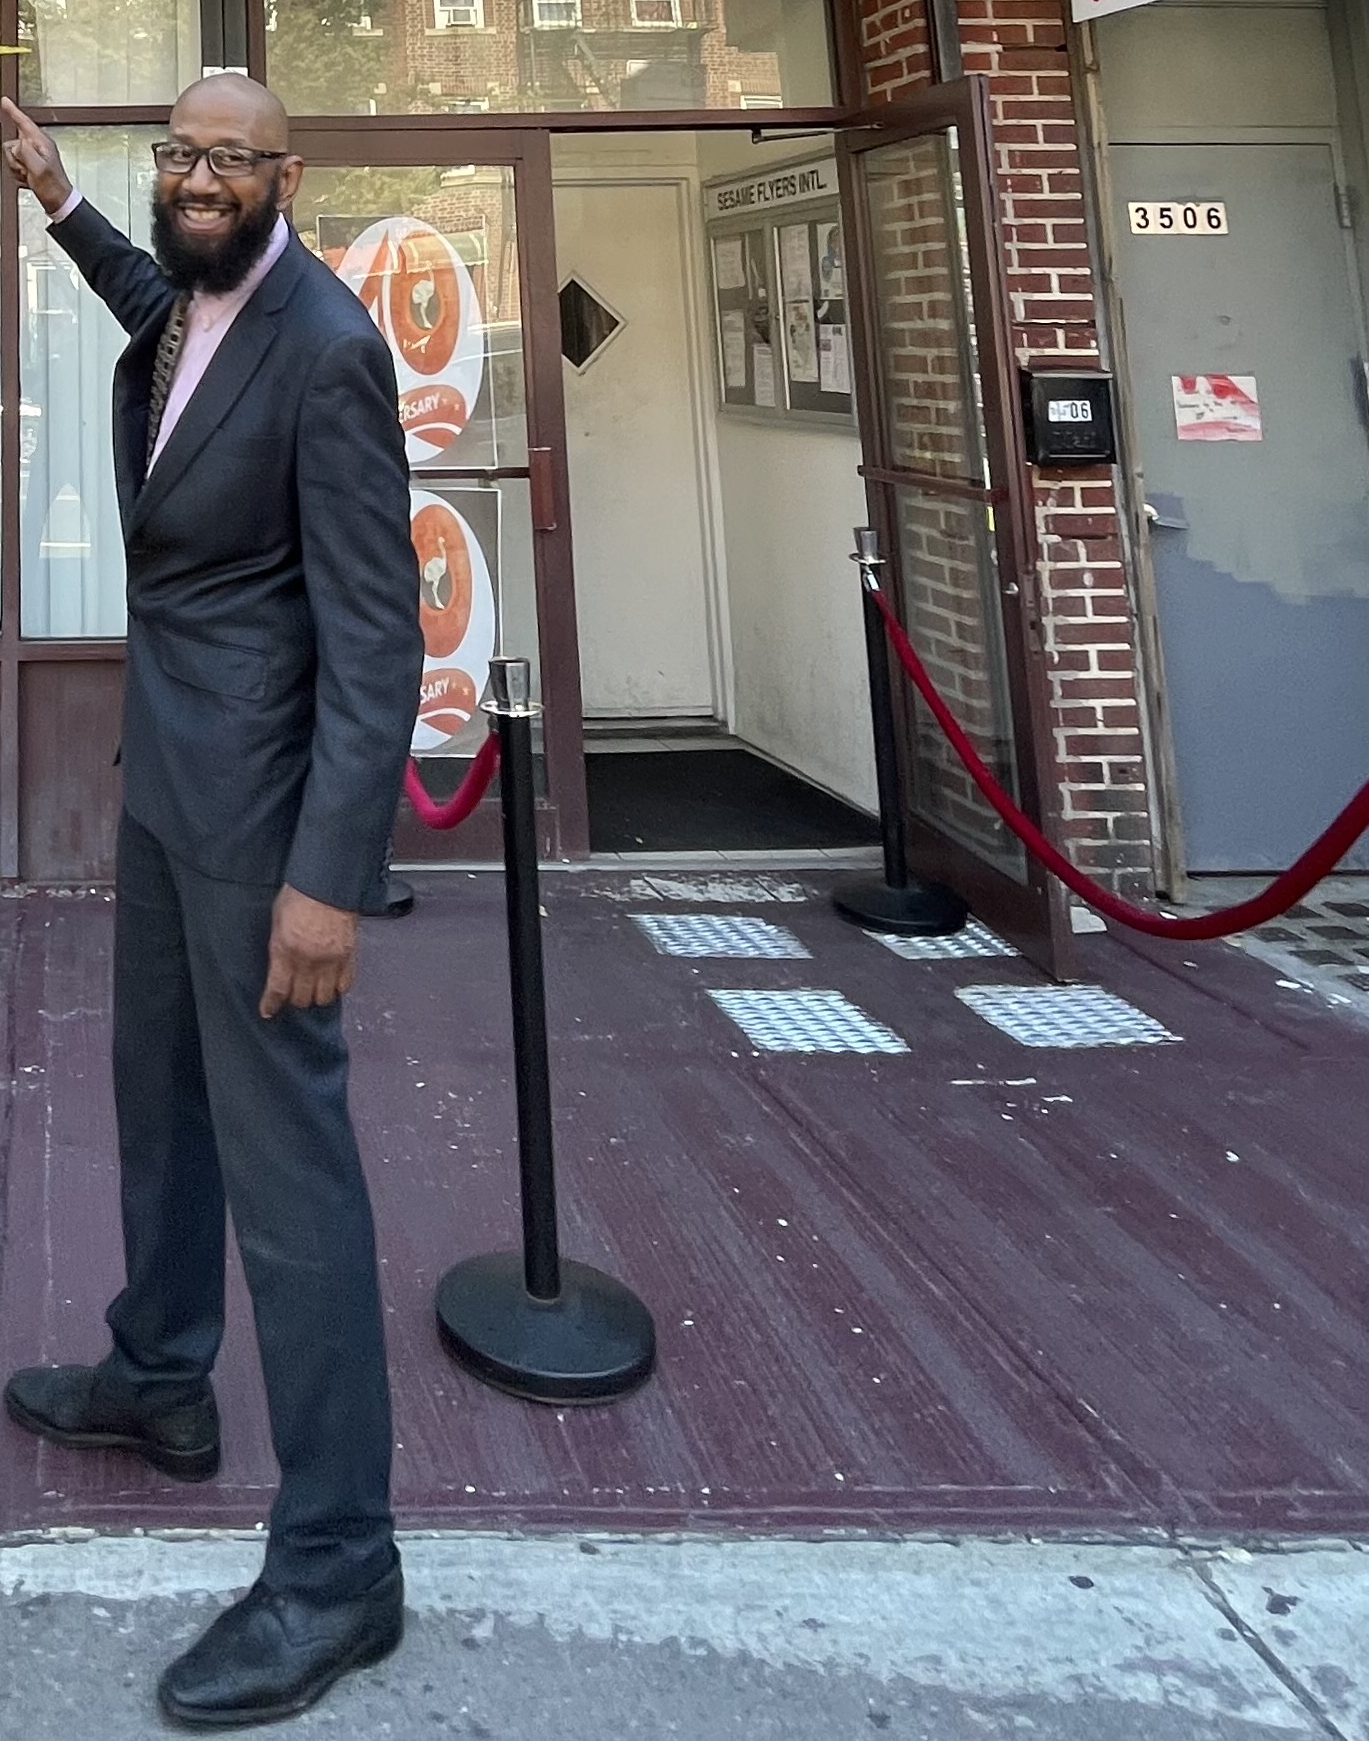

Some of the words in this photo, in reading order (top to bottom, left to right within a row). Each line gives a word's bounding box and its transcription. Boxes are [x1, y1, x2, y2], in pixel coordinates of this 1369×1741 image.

[717, 184, 755, 211] SESAME
[757, 174, 797, 203] FLYERS
[1134, 207, 1222, 230] 3506
